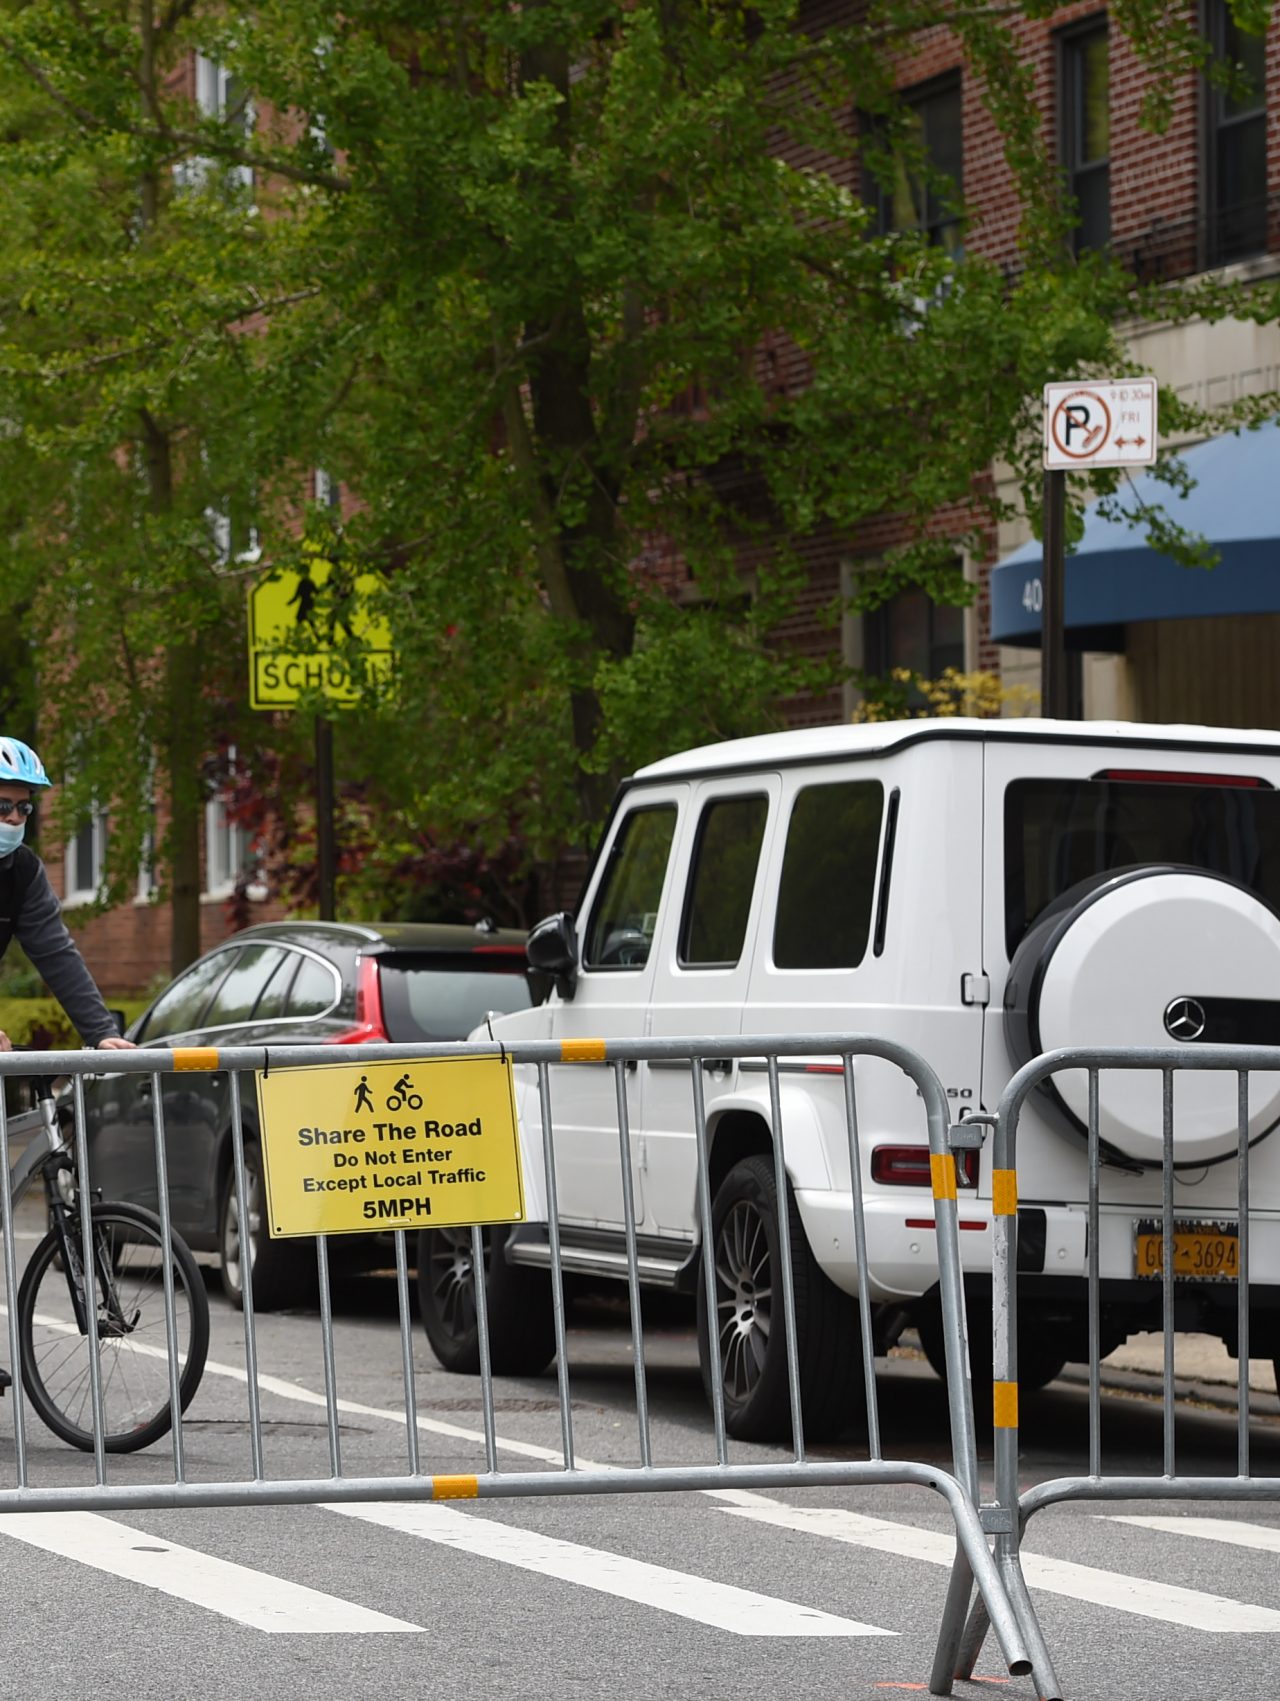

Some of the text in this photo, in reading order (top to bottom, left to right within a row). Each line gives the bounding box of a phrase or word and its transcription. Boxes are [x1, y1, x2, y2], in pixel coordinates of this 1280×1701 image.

[1121, 410, 1140, 423] FRI
[264, 662, 387, 690] SCHOL
[298, 1118, 482, 1146] Share The Road
[334, 1148, 453, 1168] Do Not Enter
[304, 1168, 486, 1193] Except Local Traffic
[363, 1197, 432, 1219] 5MPH
[1193, 1240, 1236, 1268] 3694
